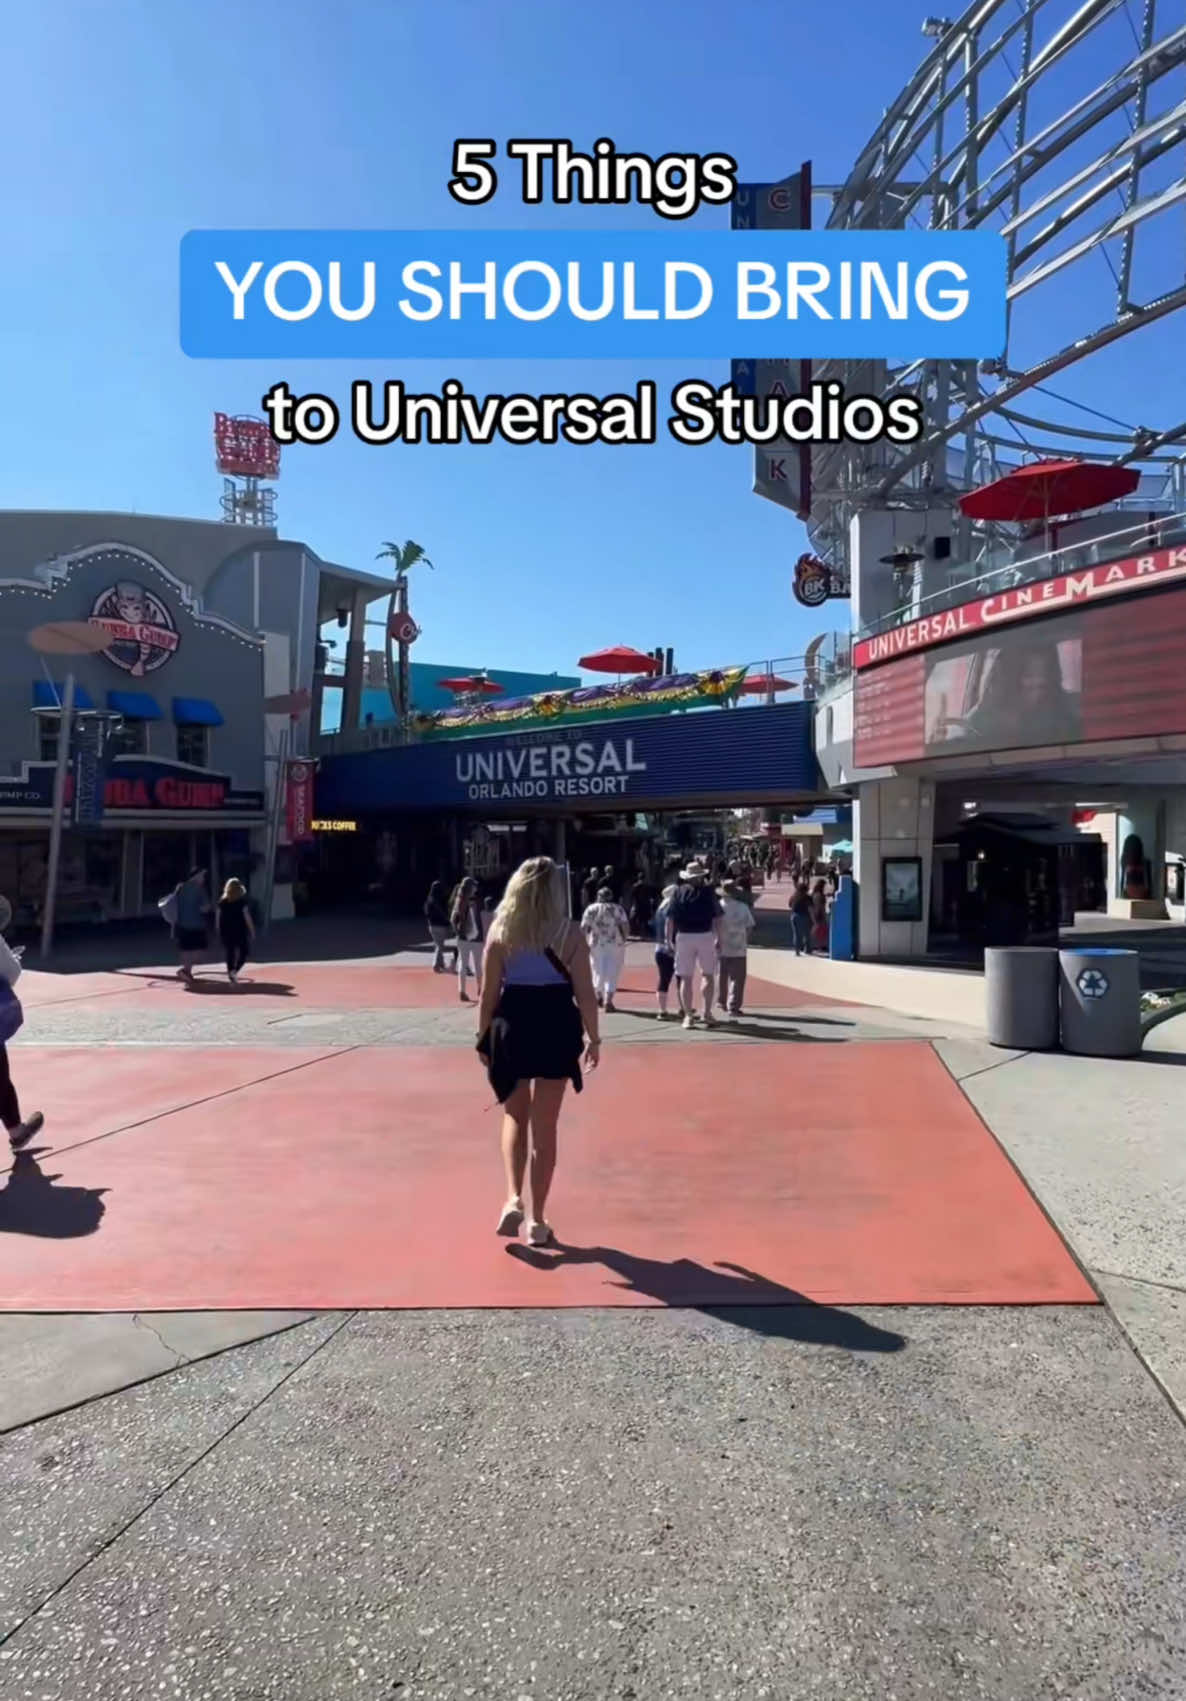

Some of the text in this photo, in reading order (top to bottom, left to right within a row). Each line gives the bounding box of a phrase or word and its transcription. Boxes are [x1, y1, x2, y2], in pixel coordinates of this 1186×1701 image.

[868, 549, 1186, 660] UNIVERSAL CINEMARK
[455, 738, 647, 782] UNIVERSAL
[468, 775, 629, 800] ORLANDO RESORT
